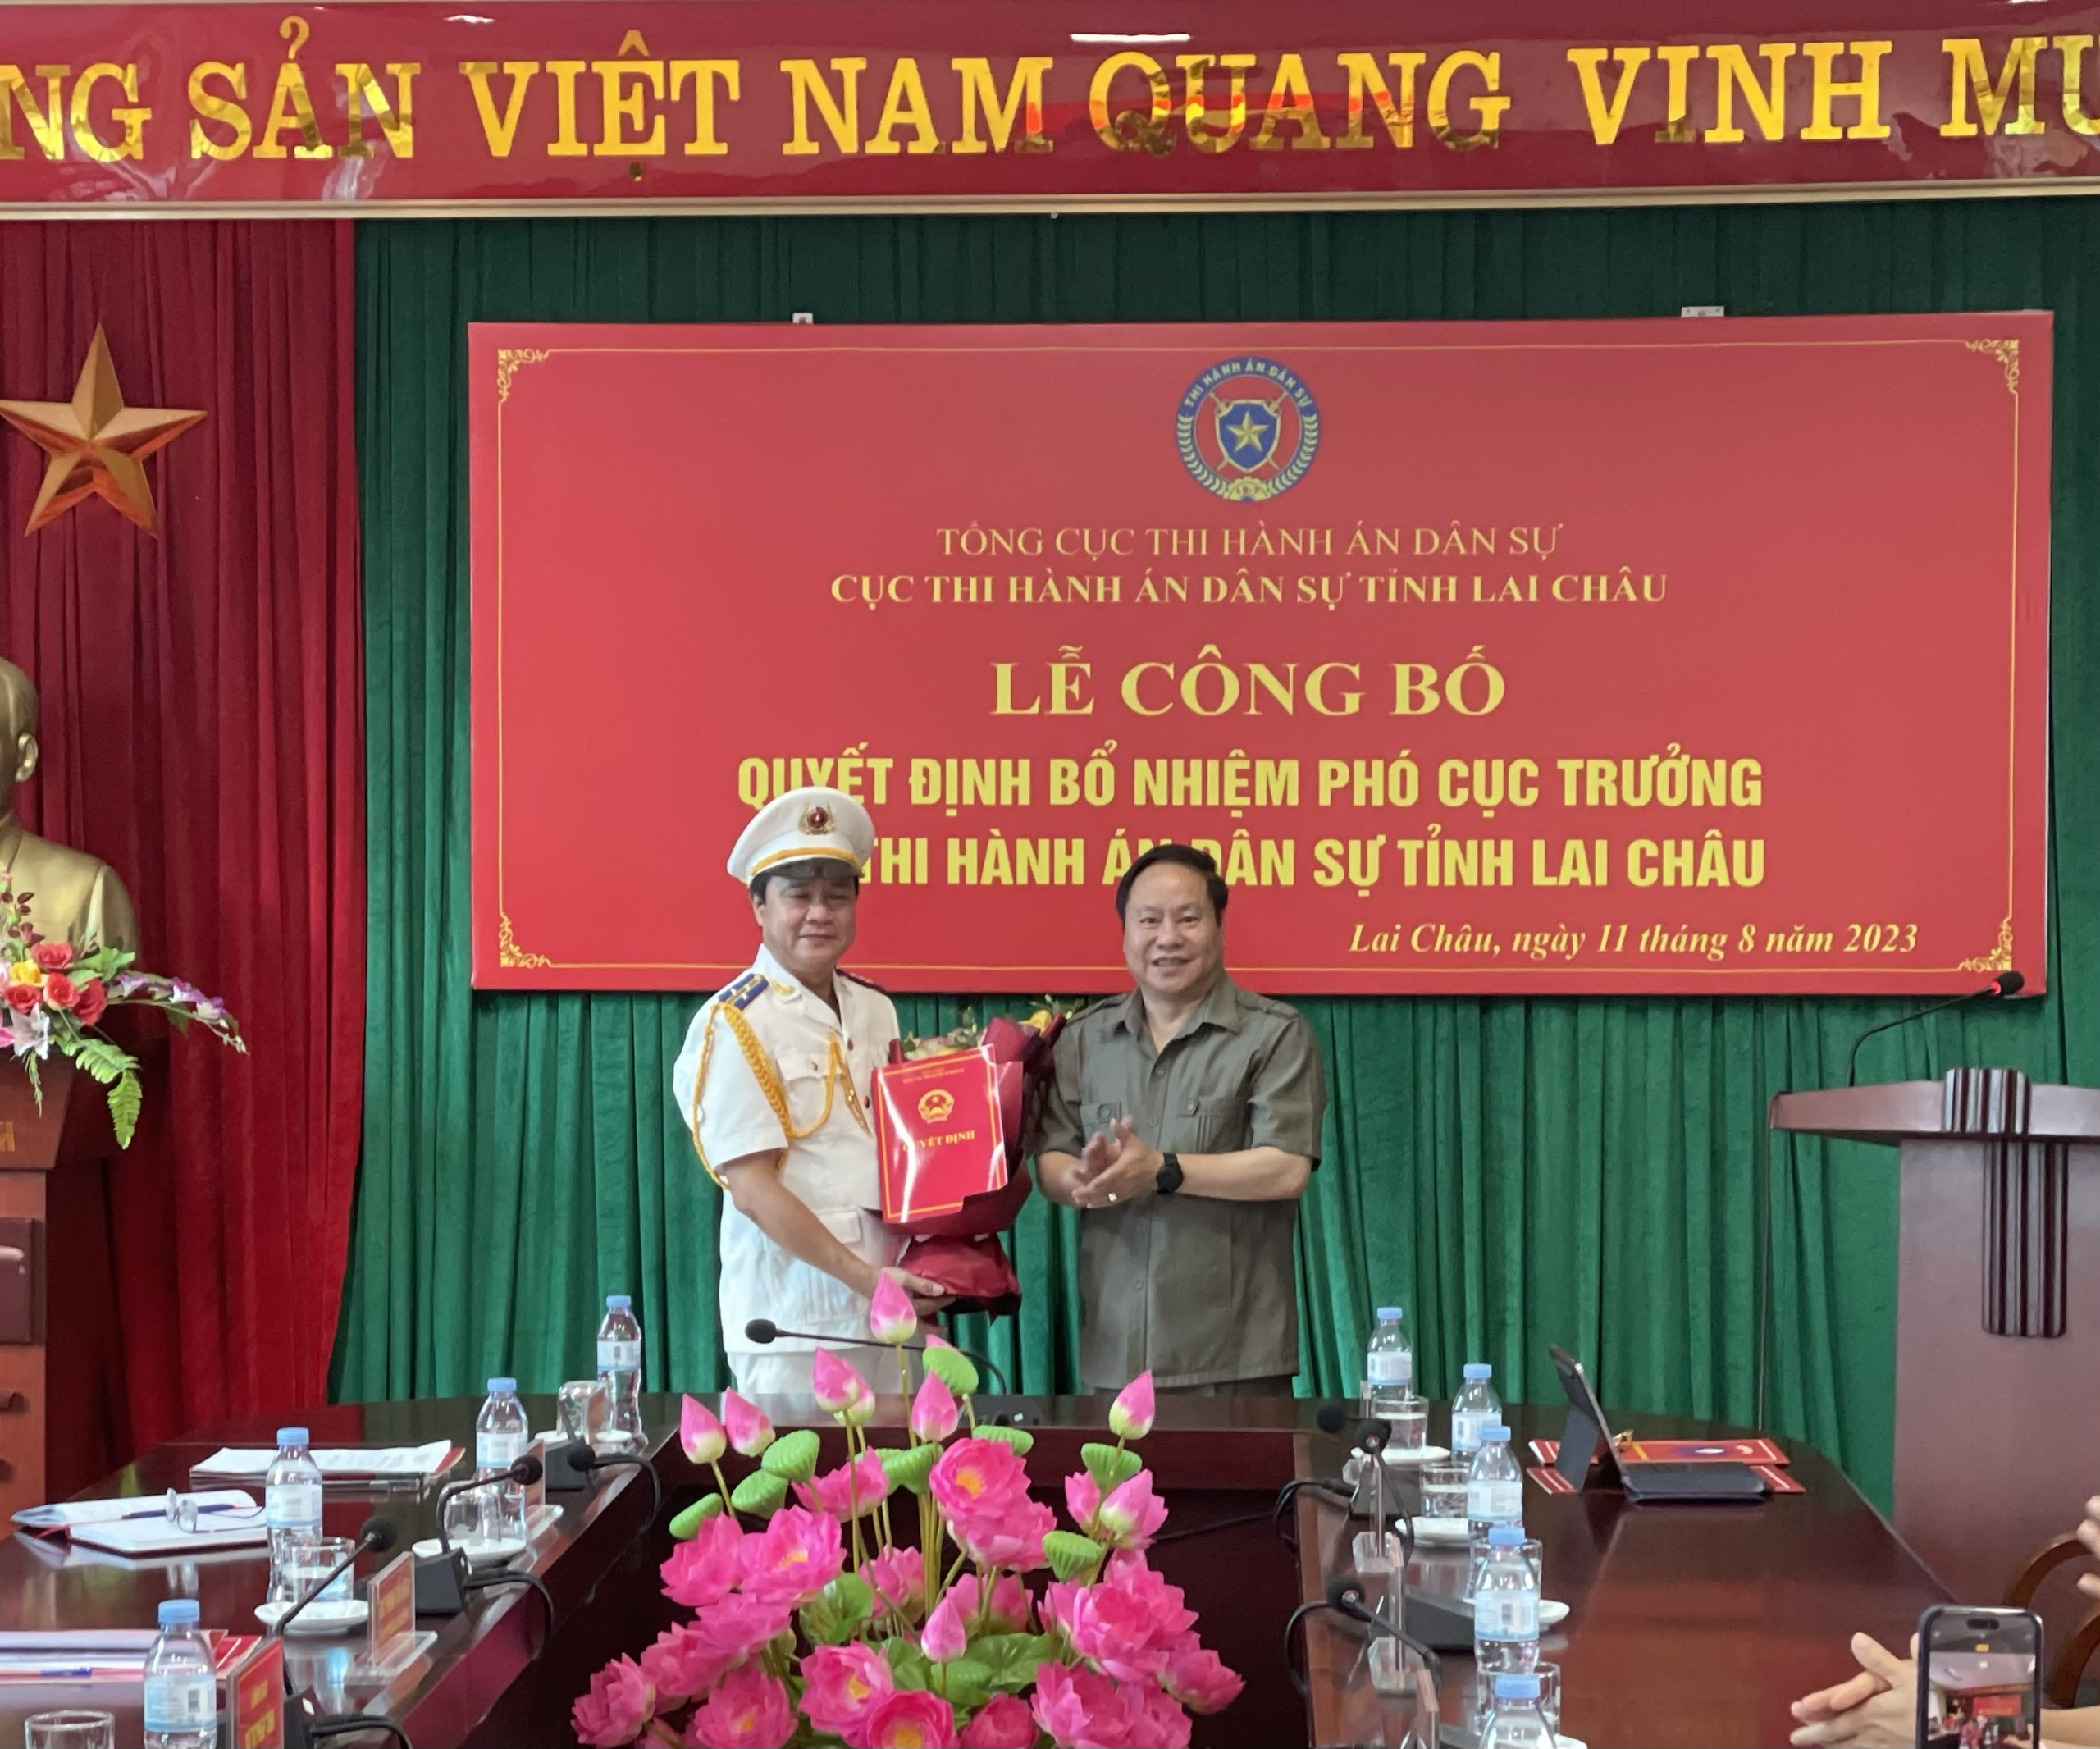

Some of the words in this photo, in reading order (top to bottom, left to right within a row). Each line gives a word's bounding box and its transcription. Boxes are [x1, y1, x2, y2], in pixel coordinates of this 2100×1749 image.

[0, 63, 152, 162] NG
[189, 16, 421, 161] SẢN
[459, 30, 741, 181] VIỆT
[780, 57, 1053, 155] NAM
[1089, 51, 1511, 155] QUANG
[1567, 40, 1893, 145] VINH
[1185, 385, 1203, 407] THI
[1245, 358, 1266, 373] ÁN
[936, 520, 1043, 555] TỔNG
[1056, 528, 1134, 561] CỤC
[1146, 529, 1207, 555] THI
[1224, 521, 1331, 555] HÀNH
[1347, 520, 1399, 555] ÁN
[1414, 520, 1495, 555] DÂN
[1510, 523, 1563, 560] SỰ
[832, 575, 913, 610] CỤC
[924, 577, 992, 602] THI
[1009, 568, 1120, 602] HÀNH
[1135, 568, 1187, 602] ÁN
[1203, 568, 1282, 602] DÂN
[1297, 572, 1351, 610] SỰ
[1359, 569, 1457, 602] TỈNH
[1474, 575, 1537, 601] LAI
[1552, 566, 1665, 601] CHÂU
[992, 646, 1093, 714] LỄ
[1121, 644, 1363, 715] CÔNG
[1391, 646, 1504, 715] BỐ
[738, 742, 894, 811] QUYẾT
[909, 758, 1030, 816] ĐỊNH
[1050, 740, 1117, 806] BỔ
[1134, 749, 1299, 818] NHIỆM
[1319, 750, 1418, 806] PHÓ
[1439, 759, 1538, 818] CỤC
[1557, 743, 1761, 806] TRƯỞNG
[947, 829, 1084, 884] HÀNH
[1102, 829, 1172, 885] Á
[1313, 834, 1386, 897] SỰ
[1397, 824, 1513, 886] TỈNH
[1533, 839, 1607, 886] LAI
[1628, 829, 1764, 887] CHÂU
[1349, 924, 1401, 952] Lai
[1411, 924, 1500, 956] Châu,
[1513, 924, 1586, 960] ngày
[1599, 925, 1628, 952] 11
[1640, 924, 1728, 961] tháng
[1738, 925, 1755, 952] 8
[1766, 925, 1833, 952] năm
[1844, 924, 1917, 952] 2023
[903, 1135, 943, 1152] YẾT
